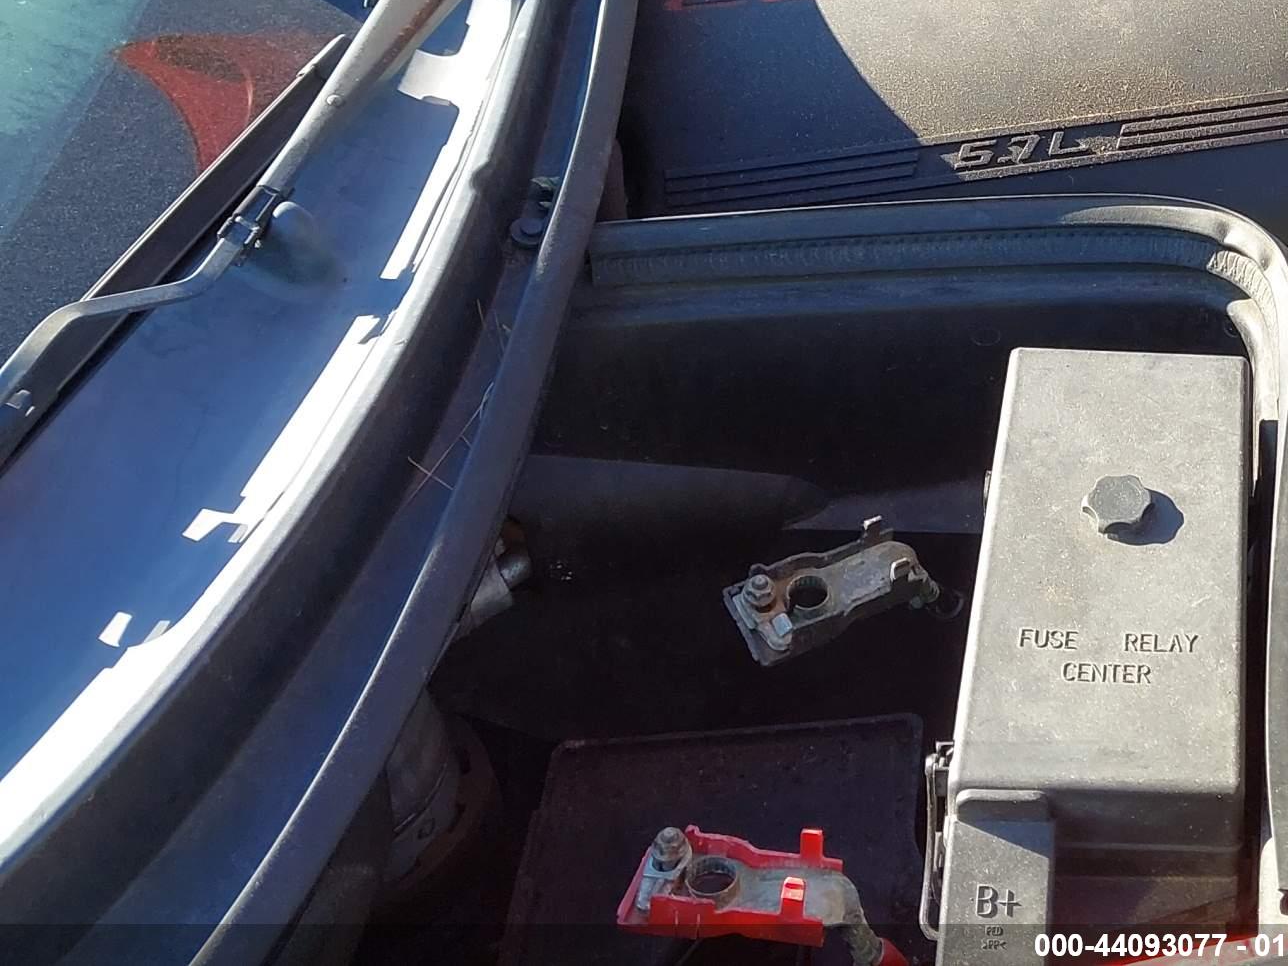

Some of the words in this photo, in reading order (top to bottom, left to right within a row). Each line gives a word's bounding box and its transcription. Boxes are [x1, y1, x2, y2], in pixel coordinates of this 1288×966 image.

[954, 131, 1088, 171] 5.7L
[1019, 628, 1079, 650] FUSE
[1124, 633, 1199, 653] RELAY
[1061, 662, 1152, 684] CENTER
[975, 884, 1023, 919] B+
